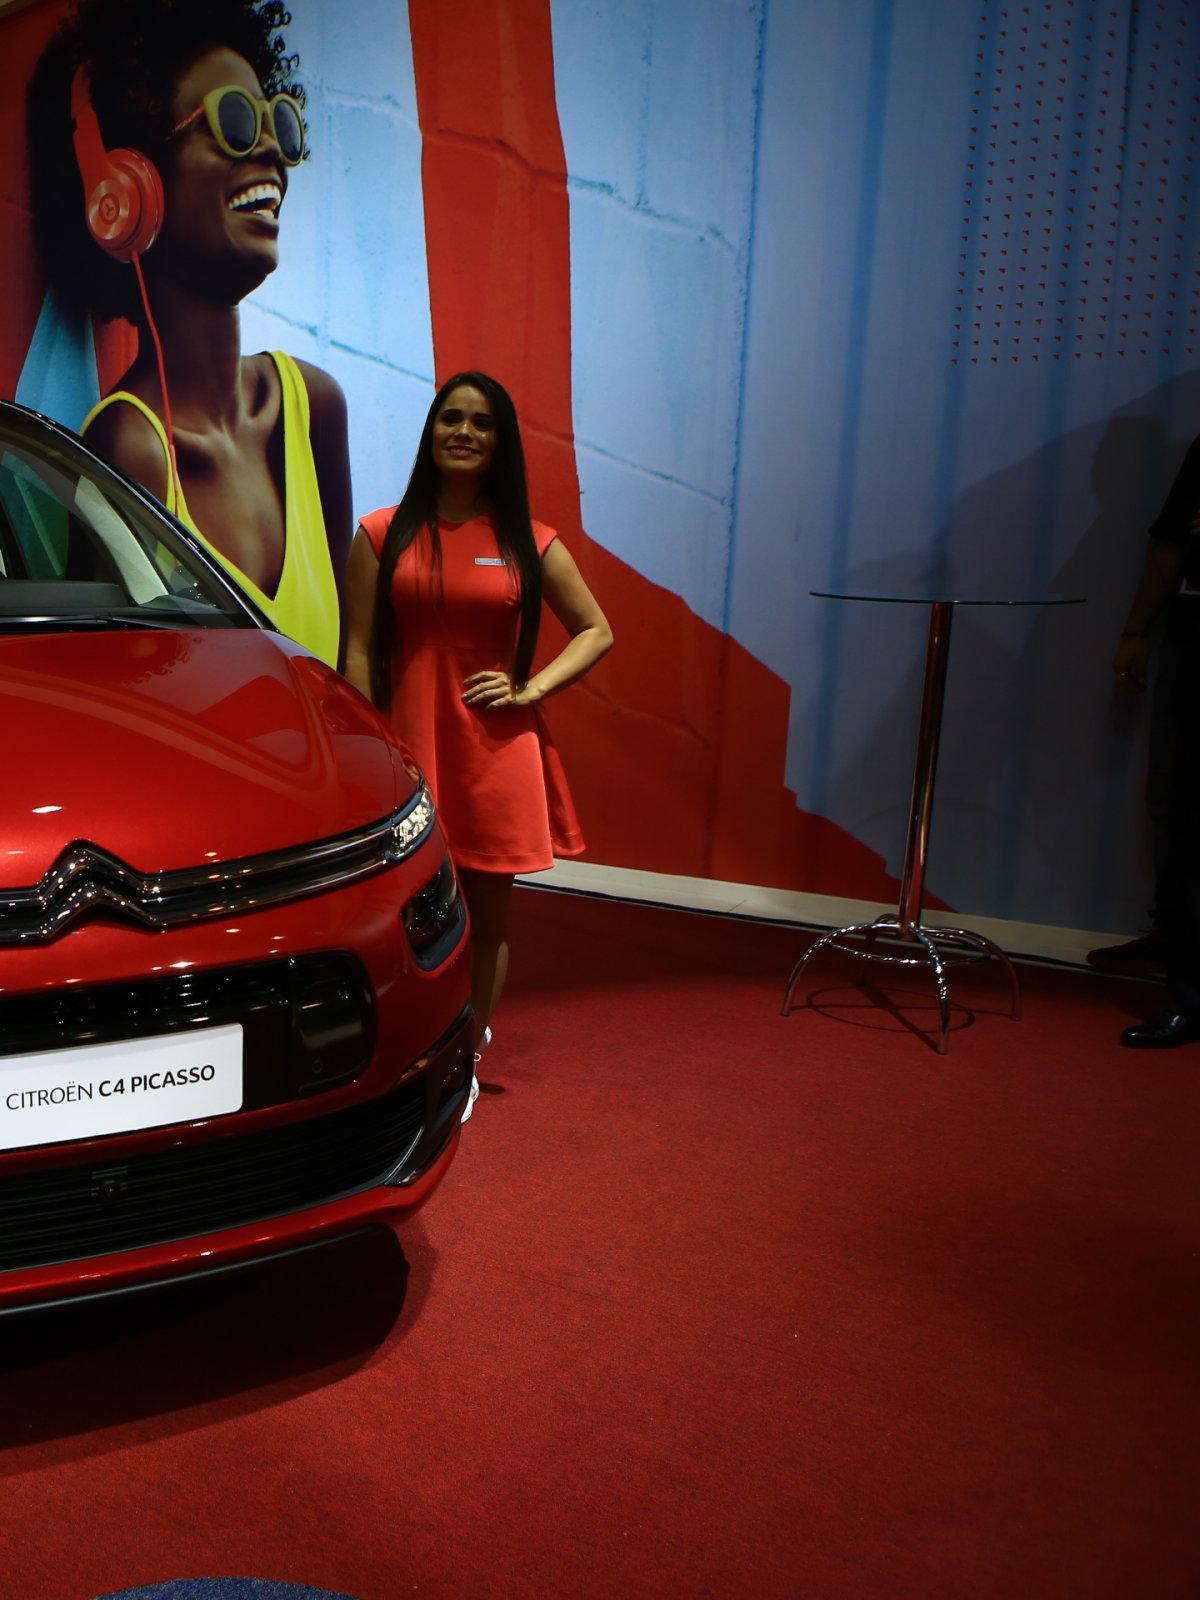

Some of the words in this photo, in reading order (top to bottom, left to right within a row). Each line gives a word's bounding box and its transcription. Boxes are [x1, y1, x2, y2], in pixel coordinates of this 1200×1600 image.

[6, 1081, 93, 1110] CITROËN
[99, 1079, 125, 1097] C4
[131, 1065, 215, 1092] PICASSO
